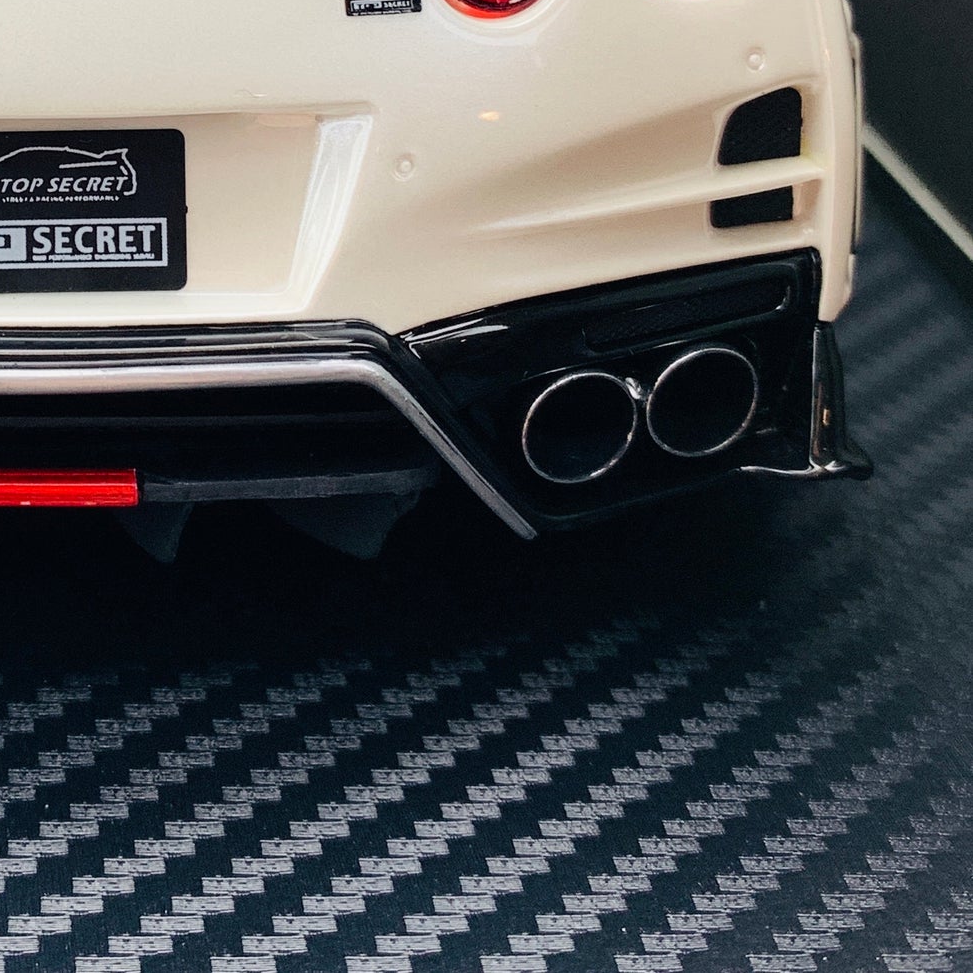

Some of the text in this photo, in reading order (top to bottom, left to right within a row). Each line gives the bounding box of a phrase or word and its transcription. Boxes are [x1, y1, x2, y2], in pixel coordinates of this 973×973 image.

[1, 176, 128, 193] TOP SECRET
[32, 225, 156, 254] SECRET
